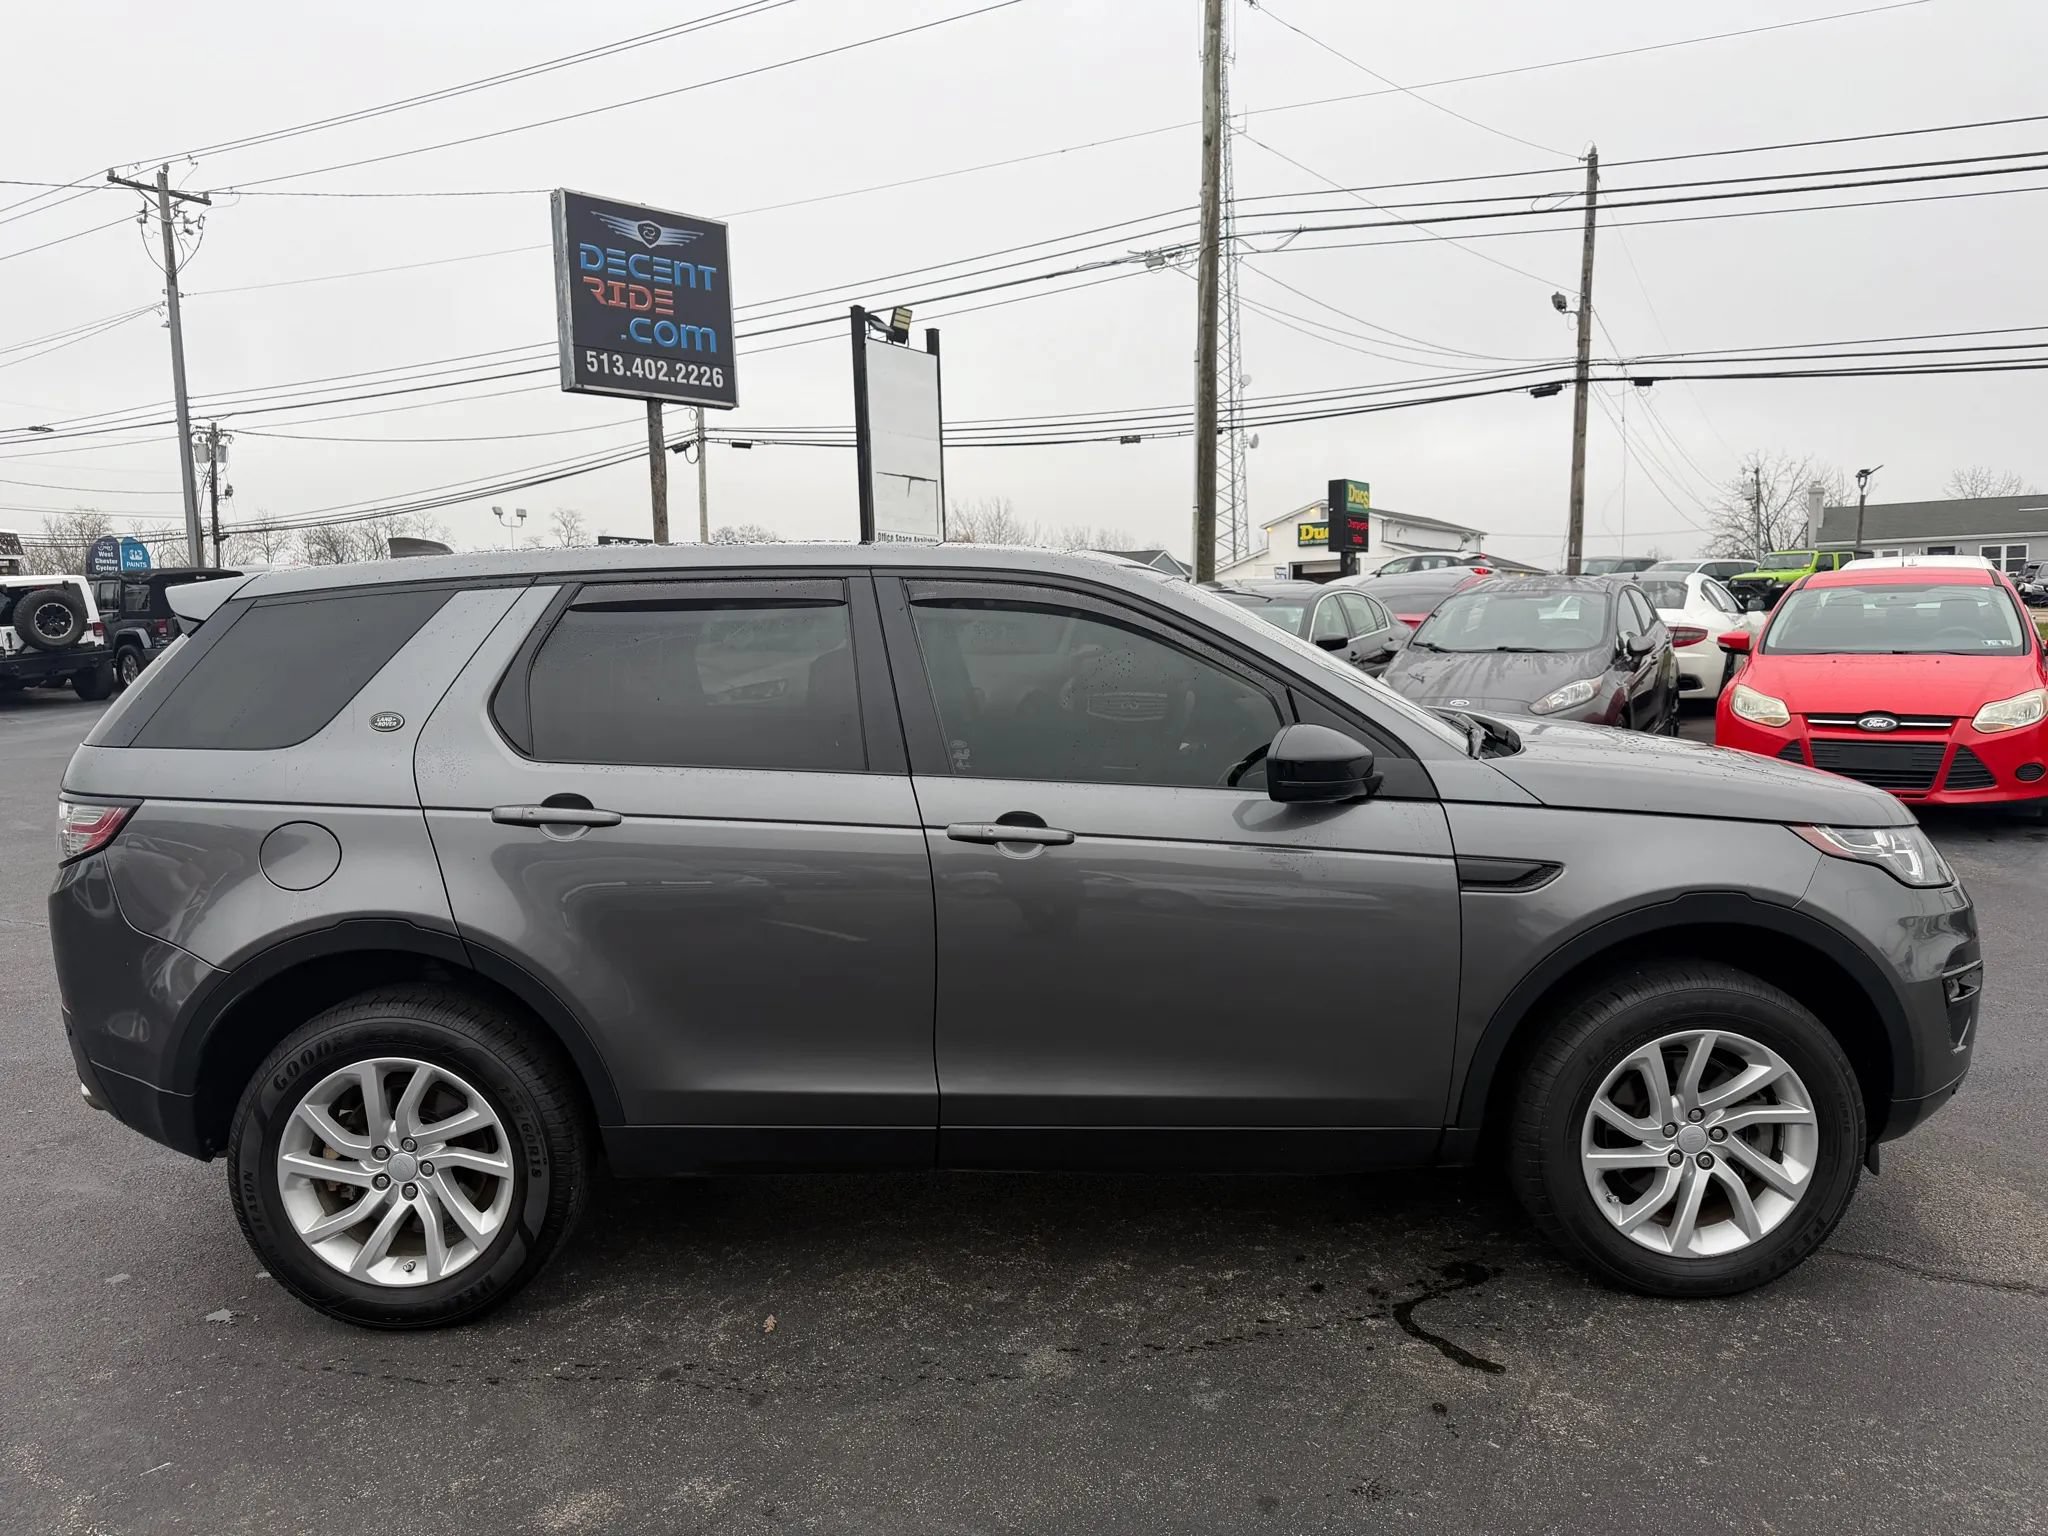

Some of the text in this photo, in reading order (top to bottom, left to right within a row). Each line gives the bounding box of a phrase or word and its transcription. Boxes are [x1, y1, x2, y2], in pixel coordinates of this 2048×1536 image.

[579, 242, 718, 291] DECENT
[583, 275, 674, 315] RIDE
[586, 350, 724, 388] 513.402.2226
[1866, 719, 1888, 728] Ford
